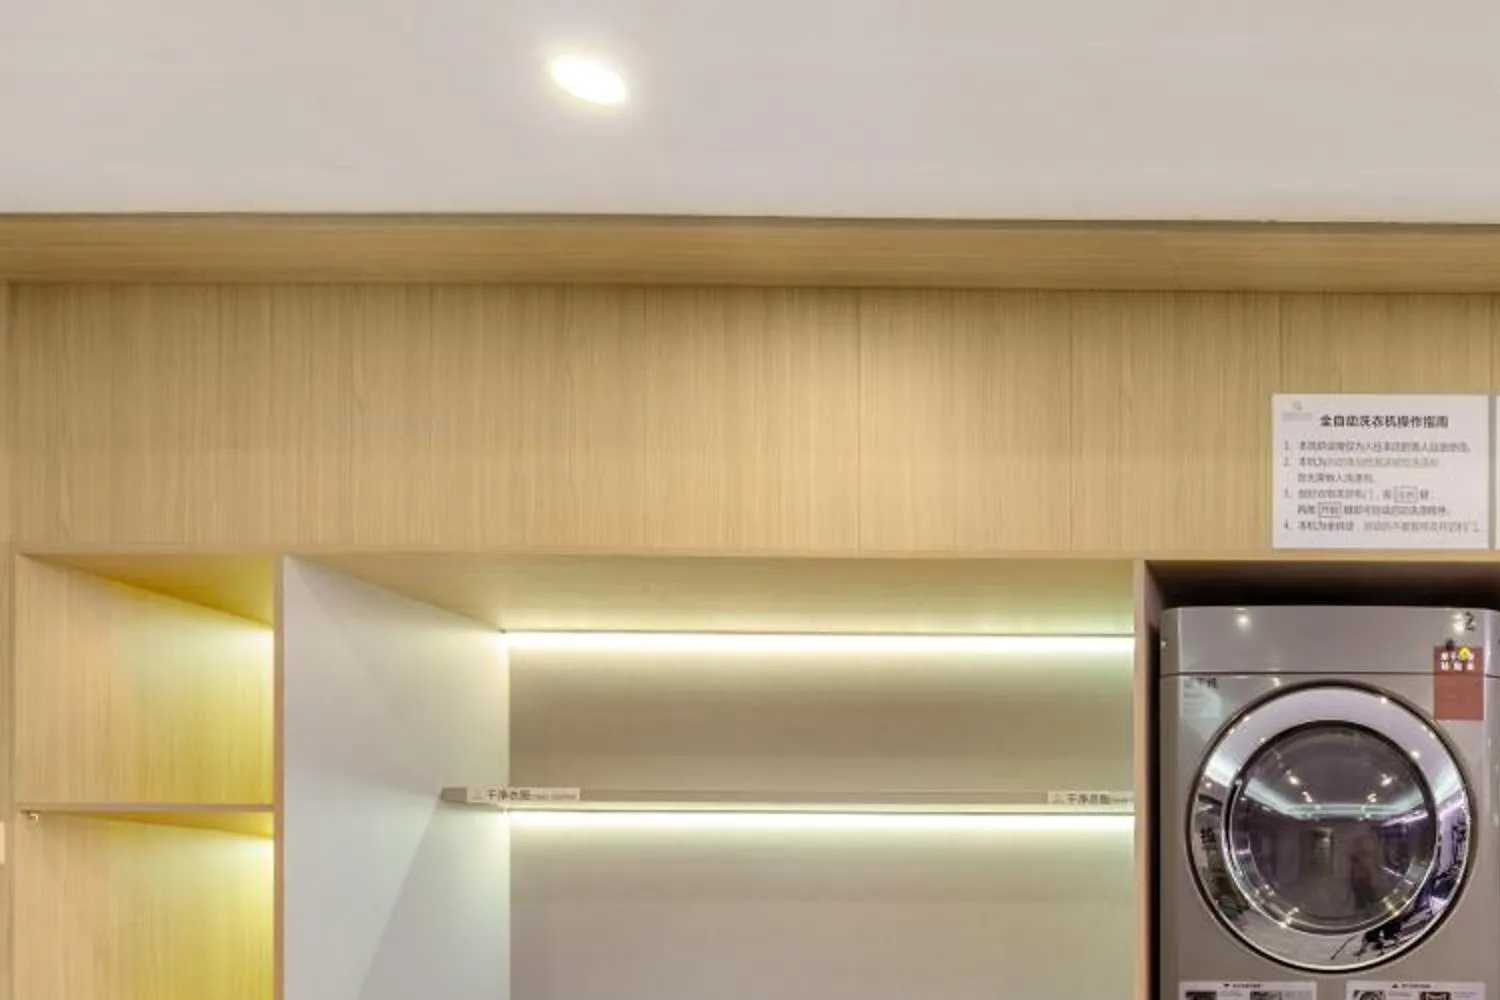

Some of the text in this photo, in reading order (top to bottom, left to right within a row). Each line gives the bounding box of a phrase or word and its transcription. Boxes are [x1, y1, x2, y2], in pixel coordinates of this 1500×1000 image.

[1319, 414, 1449, 428] 全自动洗衣机操作指南
[1464, 611, 1476, 631] 2
